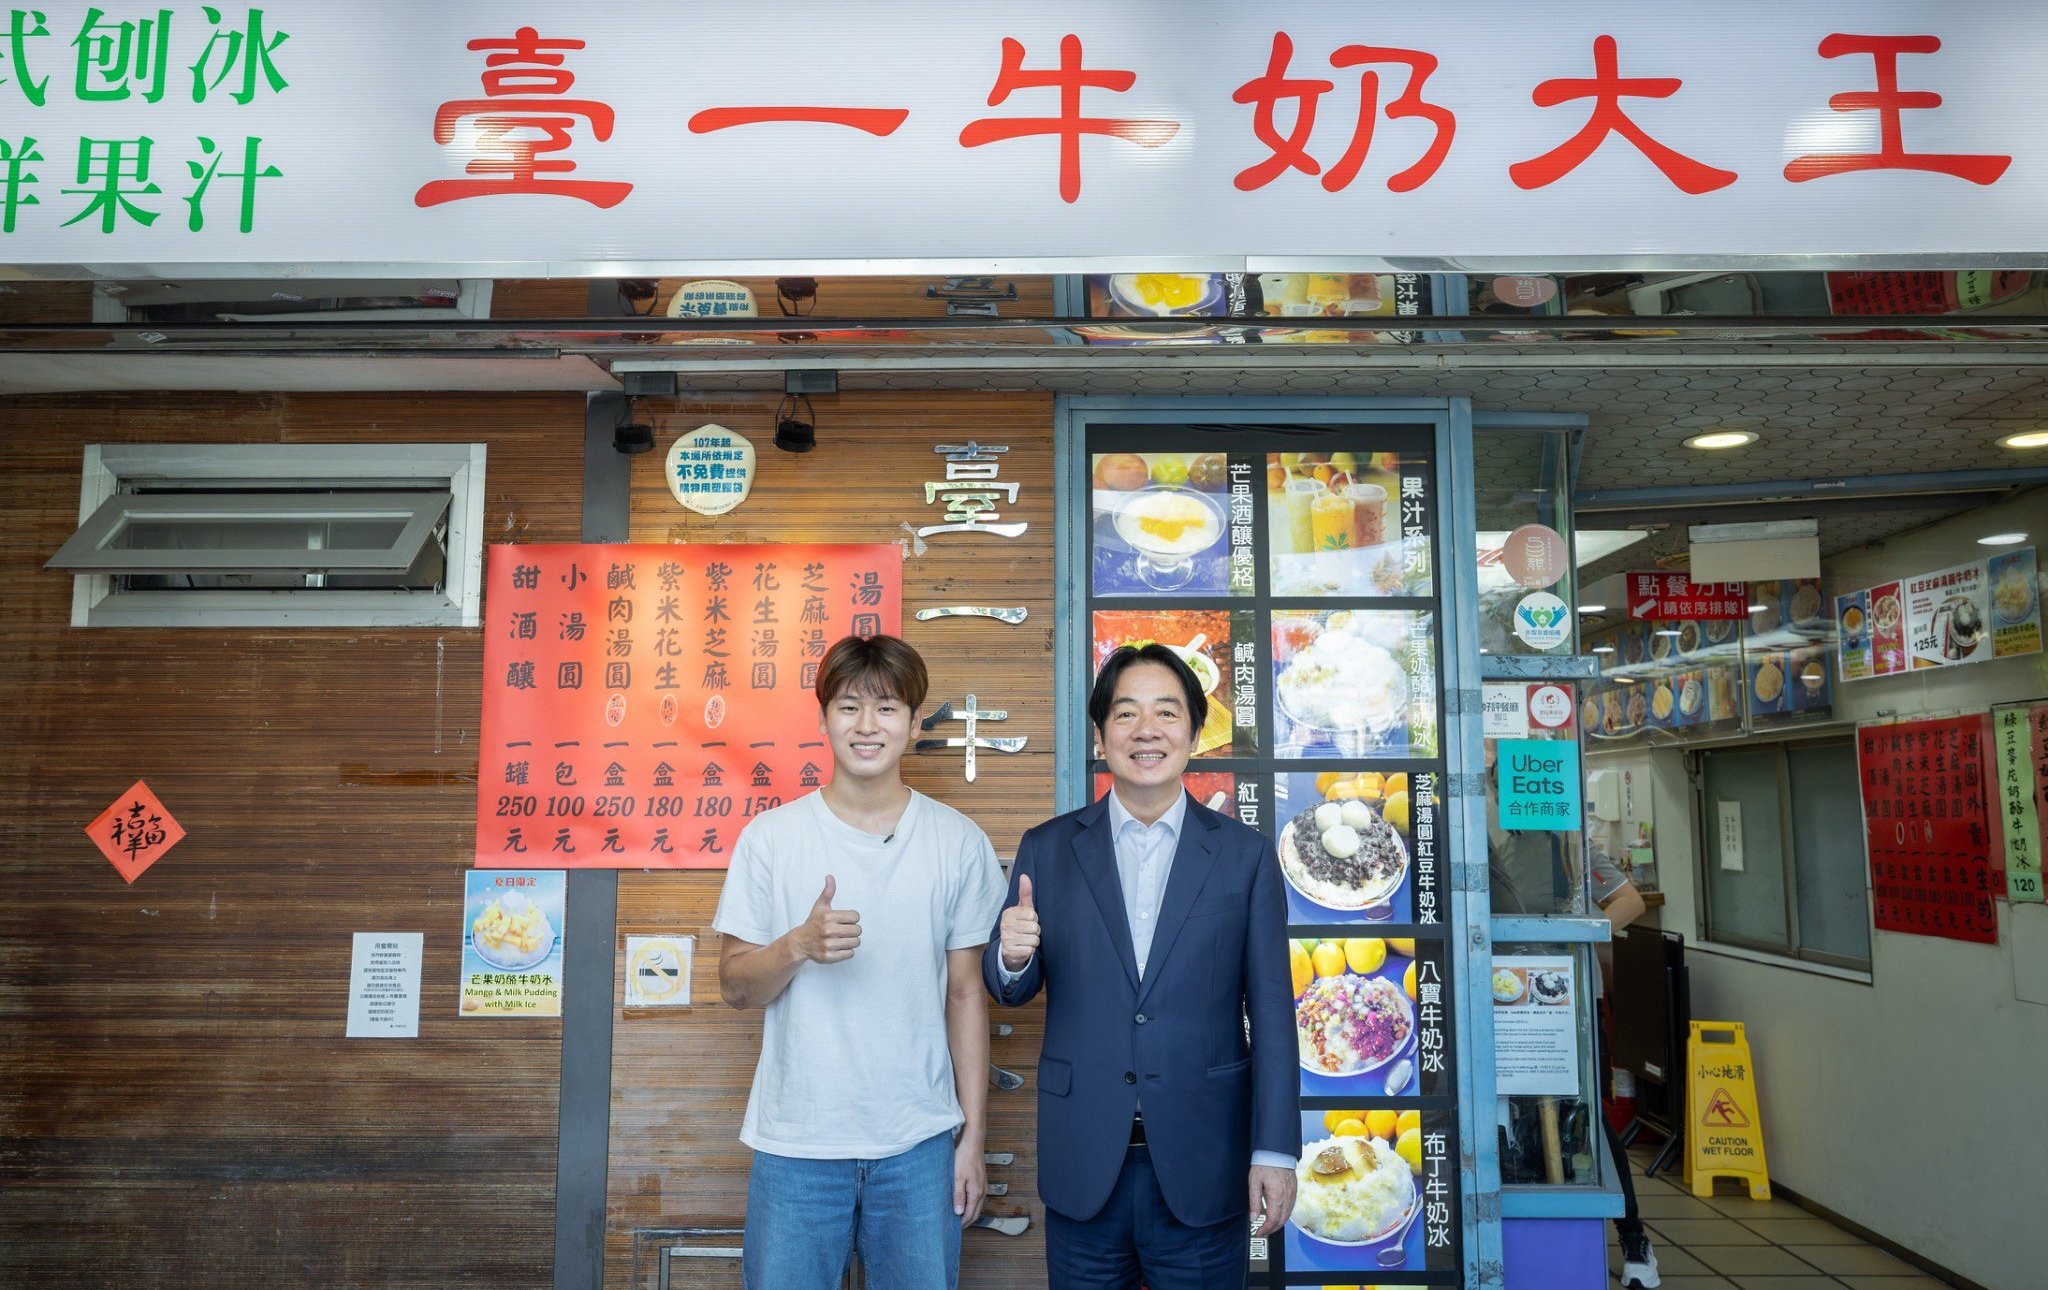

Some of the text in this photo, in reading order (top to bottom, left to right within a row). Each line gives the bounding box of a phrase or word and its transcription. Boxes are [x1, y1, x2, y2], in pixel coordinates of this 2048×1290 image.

[414, 26, 2012, 209] 臺一牛奶大王
[676, 463, 747, 480] 不免費提供
[1230, 463, 1254, 587] 芒果酒釀優格
[1402, 476, 1427, 573] 果汁系列
[506, 562, 541, 690] 甜酒釀
[557, 562, 587, 690] 小湯圓
[605, 562, 636, 691] 鹹肉湯圓
[654, 562, 685, 691] 紫米花生
[701, 562, 733, 691] 紫米芝麻
[751, 562, 780, 690] 花生湯圓
[1664, 600, 1738, 616] 請依序排隊
[1914, 635, 1938, 653] 125元
[1233, 641, 1256, 728] 鹹肉湯圓
[1512, 754, 1564, 774] Uber
[1512, 775, 1565, 795] Eats
[1238, 782, 1260, 832] 紅豆
[1508, 801, 1570, 818] 合作商家
[1415, 773, 1437, 925] 芝麻湯圓紅豆牛奶冰
[2013, 878, 2036, 893] 120
[465, 987, 558, 998] Mango & Milk Pudding
[484, 1000, 537, 1008] with Milk Ice
[1419, 961, 1445, 1073] 八寶牛奶冰
[1697, 1064, 1746, 1081] 小心地滑
[1702, 1146, 1754, 1156] WET FLOOR
[1708, 1137, 1748, 1146] CAUTION
[1424, 1132, 1450, 1248] 布丁牛奶冰
